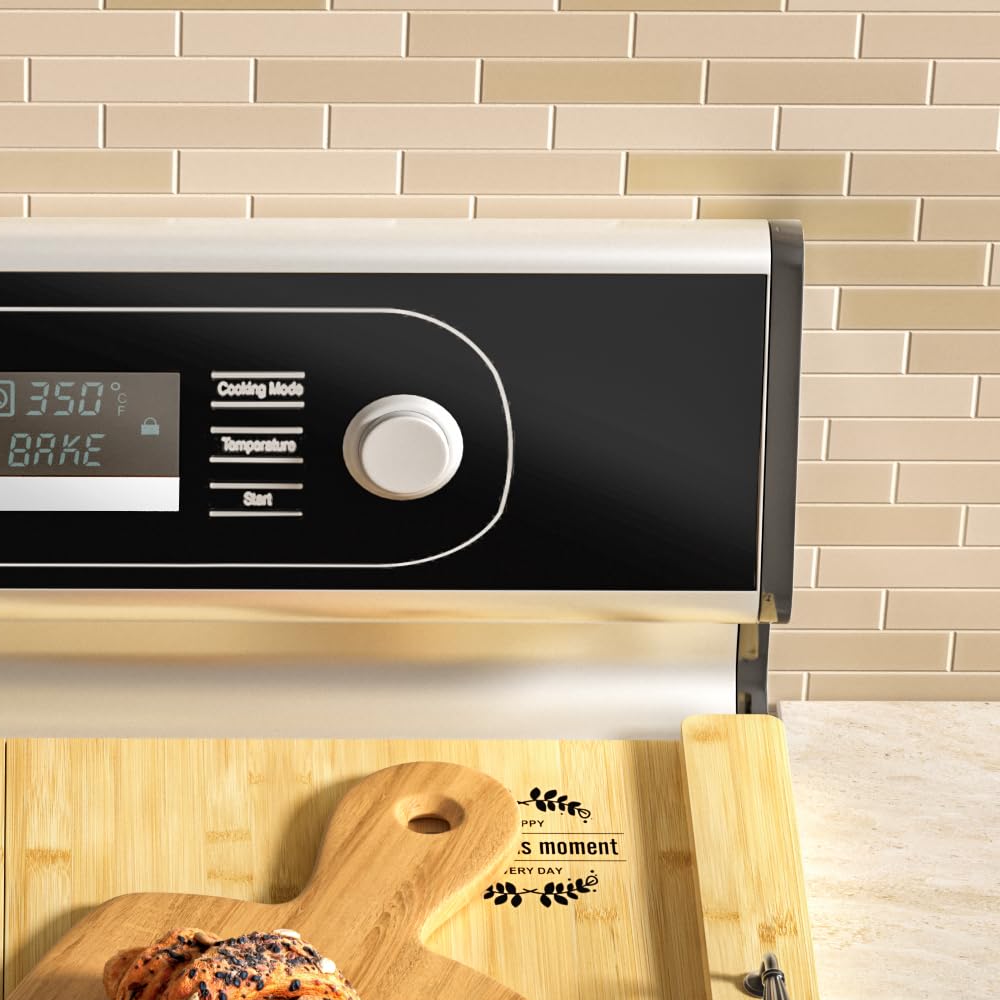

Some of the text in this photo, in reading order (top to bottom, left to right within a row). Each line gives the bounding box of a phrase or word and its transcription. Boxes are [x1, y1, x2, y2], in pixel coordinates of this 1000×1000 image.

[25, 381, 104, 416] 350
[217, 381, 304, 399] Cooking Mode
[8, 433, 105, 467] BAKE
[221, 436, 297, 455] Temperature
[243, 491, 273, 506] Start
[521, 820, 544, 828] PPY
[539, 838, 619, 855] moment
[537, 867, 563, 875] DAY
